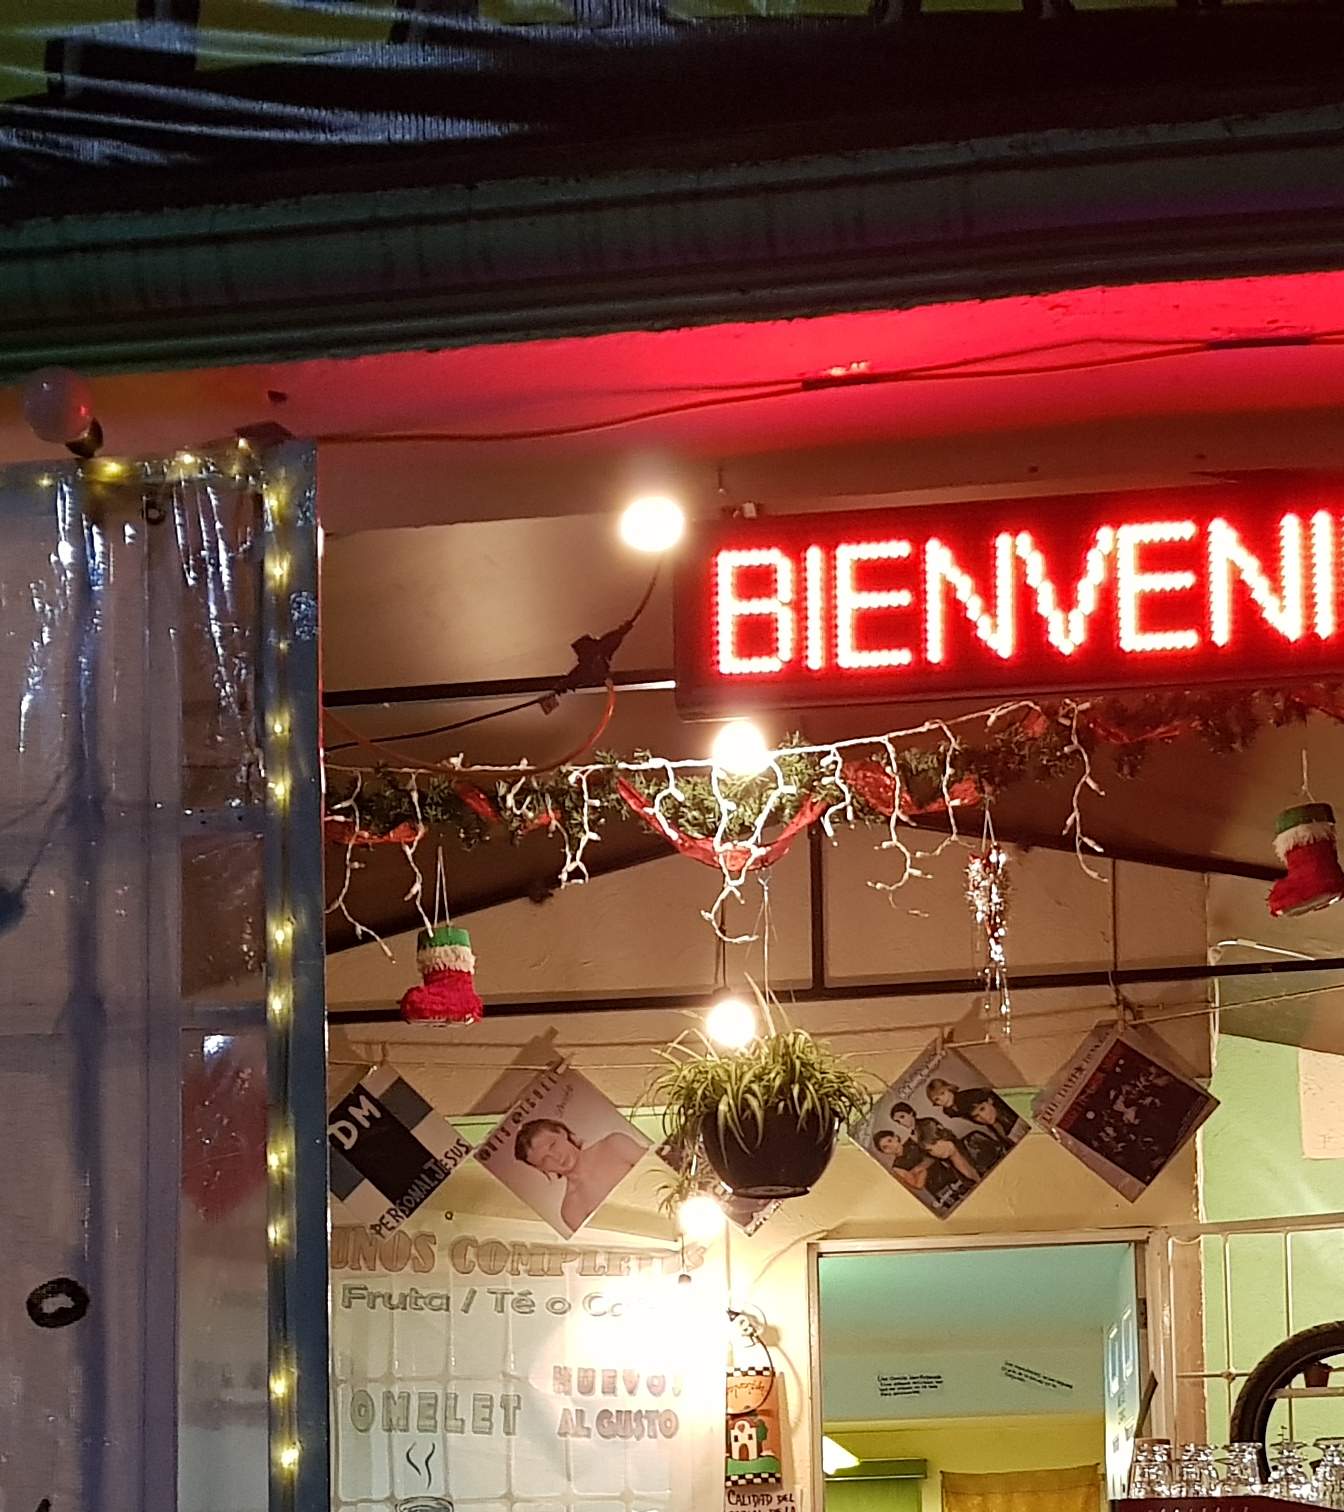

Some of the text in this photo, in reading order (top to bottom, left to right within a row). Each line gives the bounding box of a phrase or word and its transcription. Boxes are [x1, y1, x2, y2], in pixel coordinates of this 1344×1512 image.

[327, 1095, 382, 1150] DM
[370, 1137, 470, 1239] PERSONAL JESUS
[342, 1284, 451, 1312] Fruta
[486, 1286, 535, 1315] Té
[544, 1293, 572, 1316] o
[350, 1389, 523, 1437] OMELET
[557, 1408, 680, 1441] AL GUSTO
